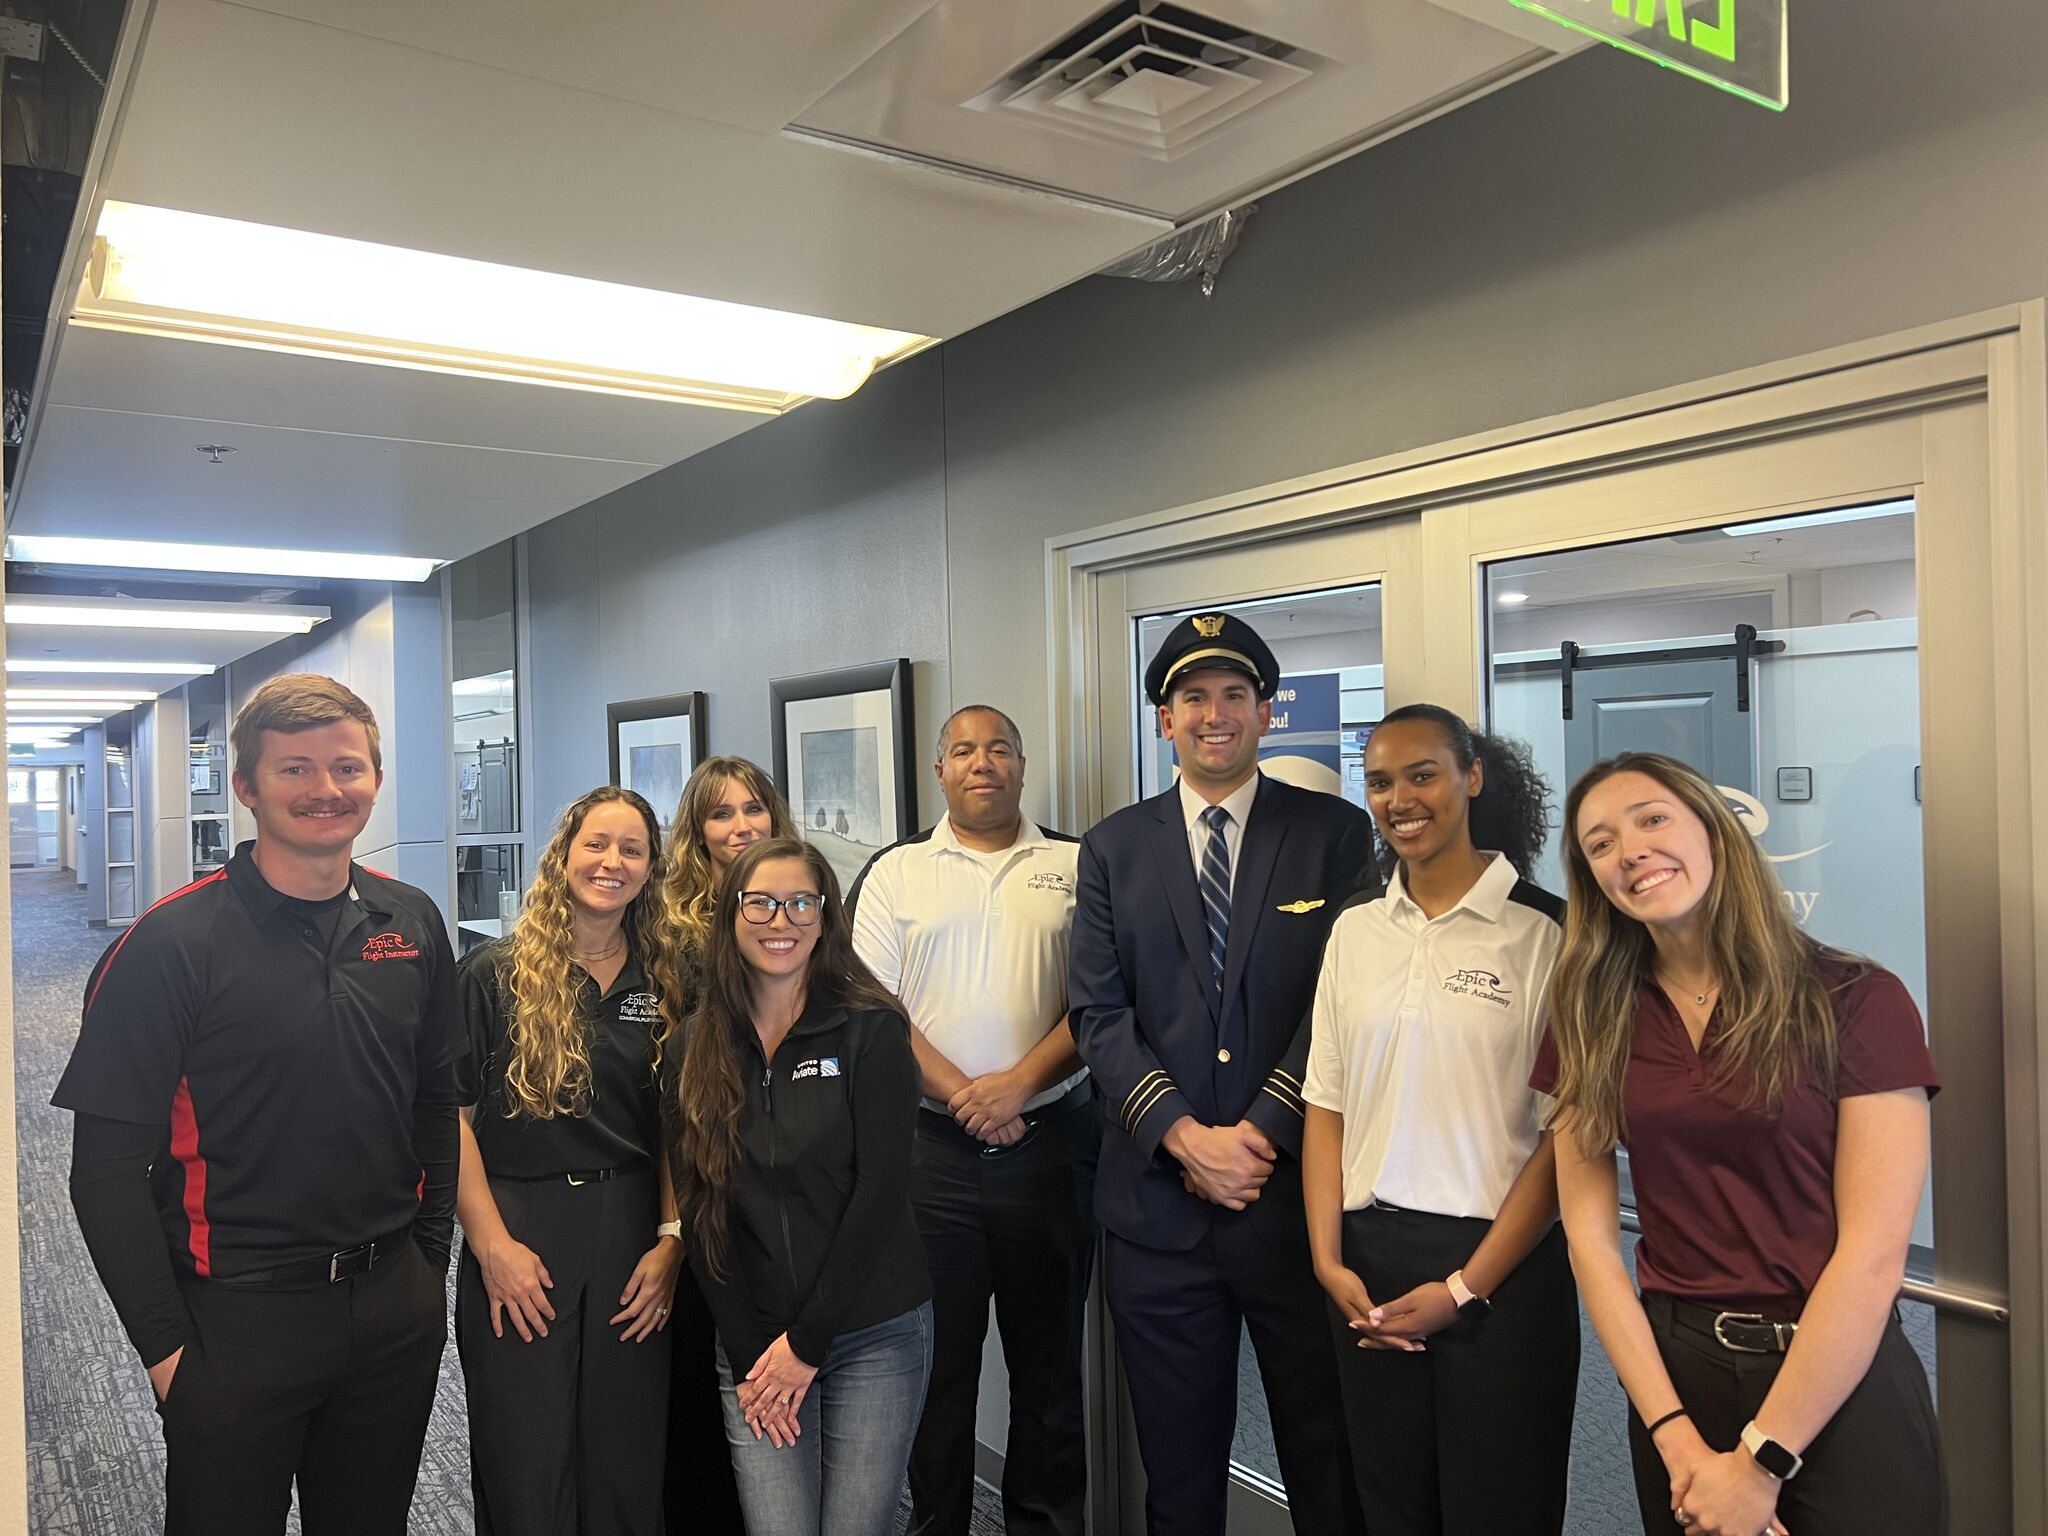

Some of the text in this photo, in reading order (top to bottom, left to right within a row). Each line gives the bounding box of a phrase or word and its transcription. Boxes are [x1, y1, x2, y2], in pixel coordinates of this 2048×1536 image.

[1277, 689, 1296, 702] we
[1268, 712, 1289, 729] ou!
[1034, 873, 1055, 883] Epic
[368, 937, 394, 951] Epic
[362, 952, 384, 961] Flight
[1456, 970, 1486, 986] Epic
[628, 994, 648, 1008] Epic
[1443, 983, 1511, 1008] Flight Academy
[620, 1006, 638, 1015] Flight
[792, 1066, 819, 1081] Aviate
